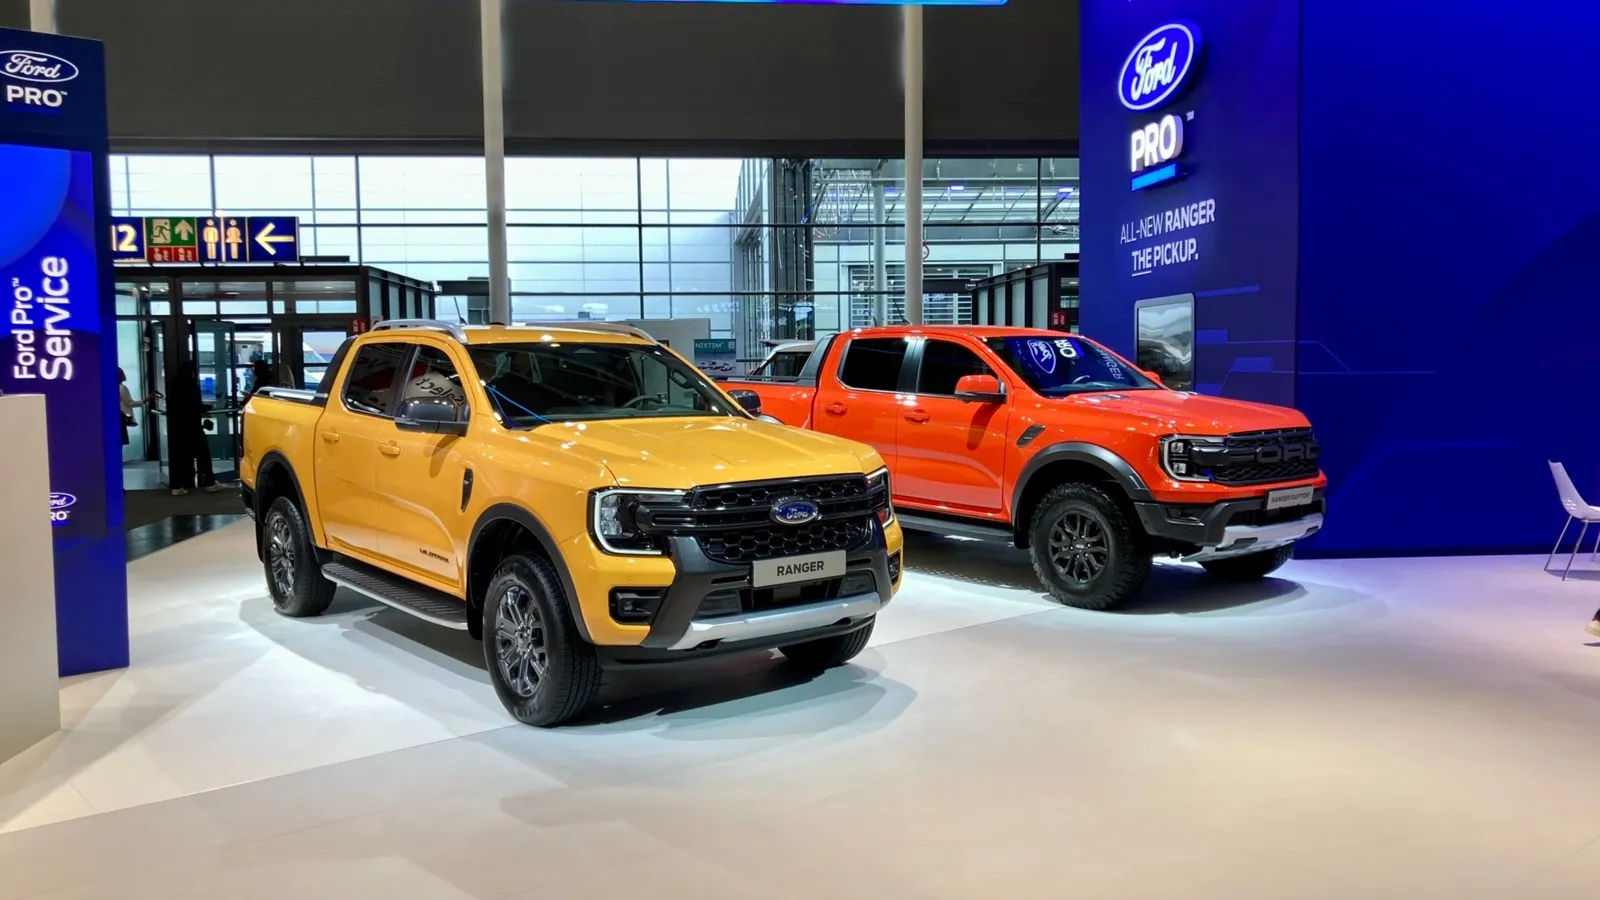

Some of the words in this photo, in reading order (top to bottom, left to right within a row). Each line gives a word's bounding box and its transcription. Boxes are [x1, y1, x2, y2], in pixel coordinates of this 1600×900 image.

[5, 53, 62, 79] Ford
[1130, 37, 1178, 101] Ford
[1120, 212, 1164, 245] ALL-NEW
[1165, 198, 1216, 233] RANGER
[1131, 247, 1153, 271] THE
[1153, 237, 1199, 267] PICKUP.
[35, 256, 73, 381] Service
[10, 329, 37, 379] Ford
[776, 560, 825, 577] RANGER
